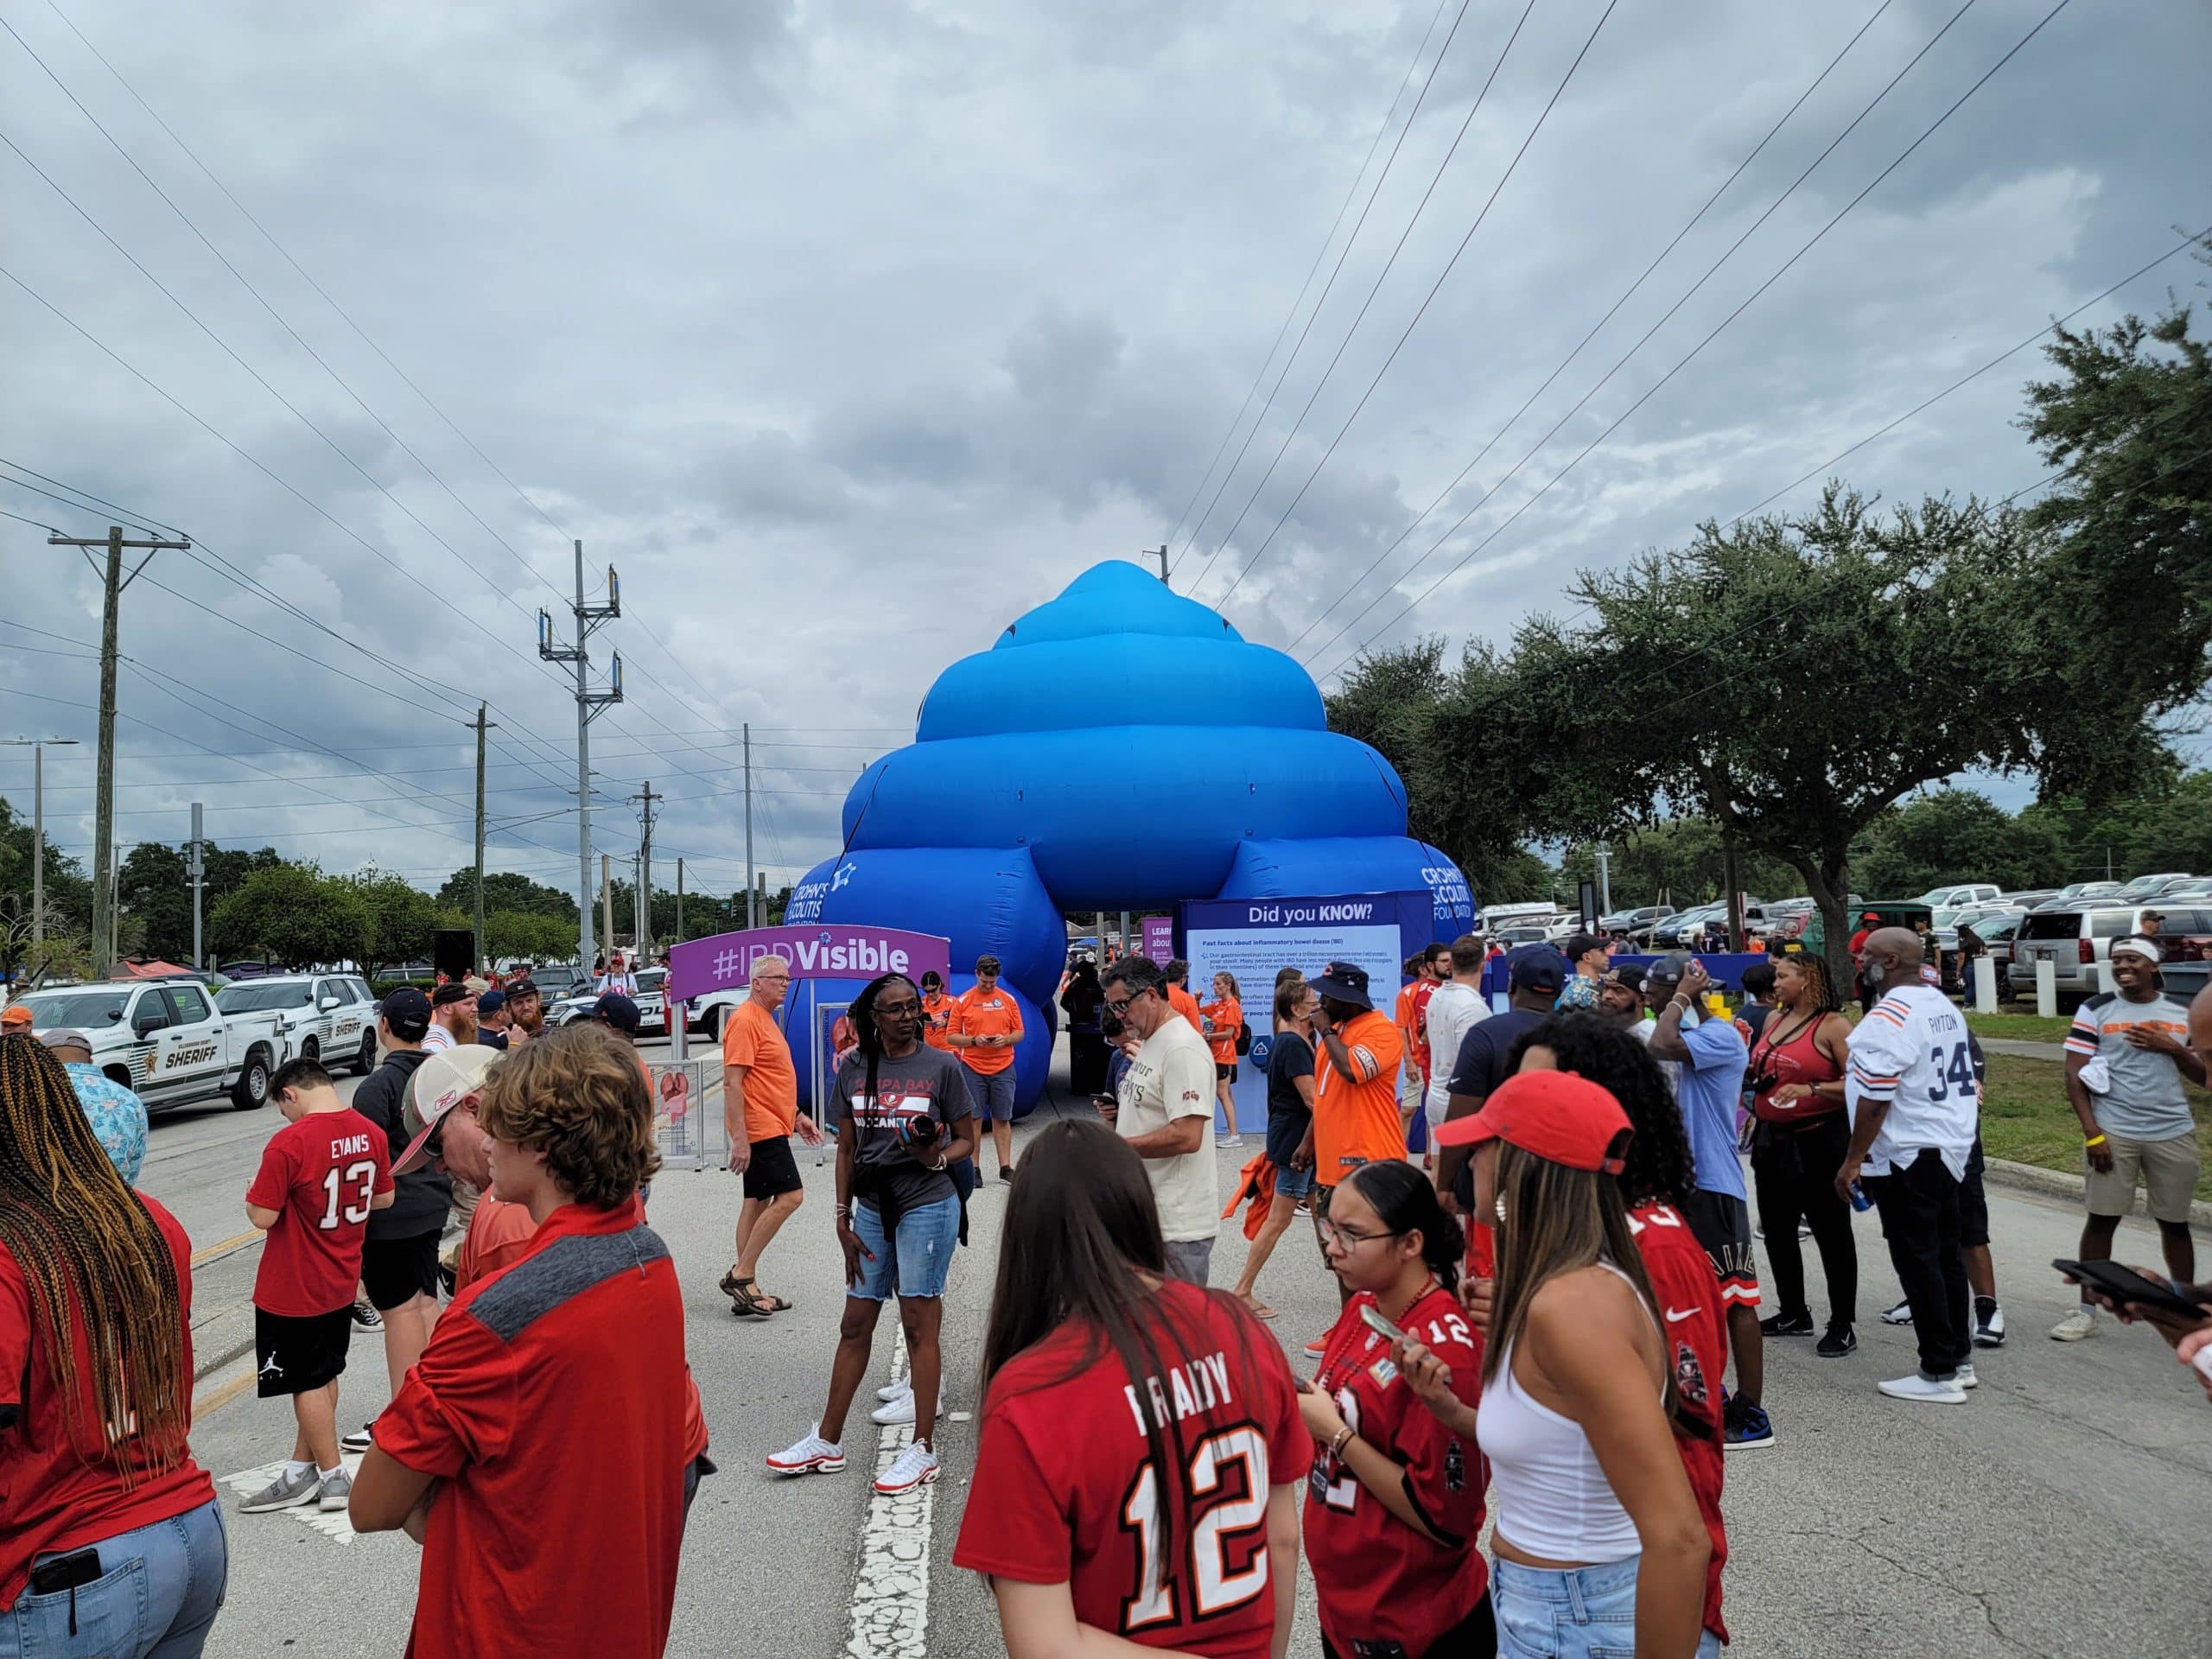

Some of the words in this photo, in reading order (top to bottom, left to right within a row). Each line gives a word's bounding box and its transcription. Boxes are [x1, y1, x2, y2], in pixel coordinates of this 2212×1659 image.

[1249, 906, 1279, 923] Did
[1283, 908, 1315, 925] you
[1319, 904, 1373, 920] KNOW?
[335, 1022, 361, 1037] SHERIFF
[166, 1046, 218, 1069] SHERIFF
[906, 1077, 934, 1090] BAY
[1928, 1042, 1976, 1102] 34
[331, 1134, 370, 1159] EVANS
[319, 1160, 378, 1229] 13
[1427, 1313, 1474, 1349] 12
[1122, 1422, 1270, 1632] 12
